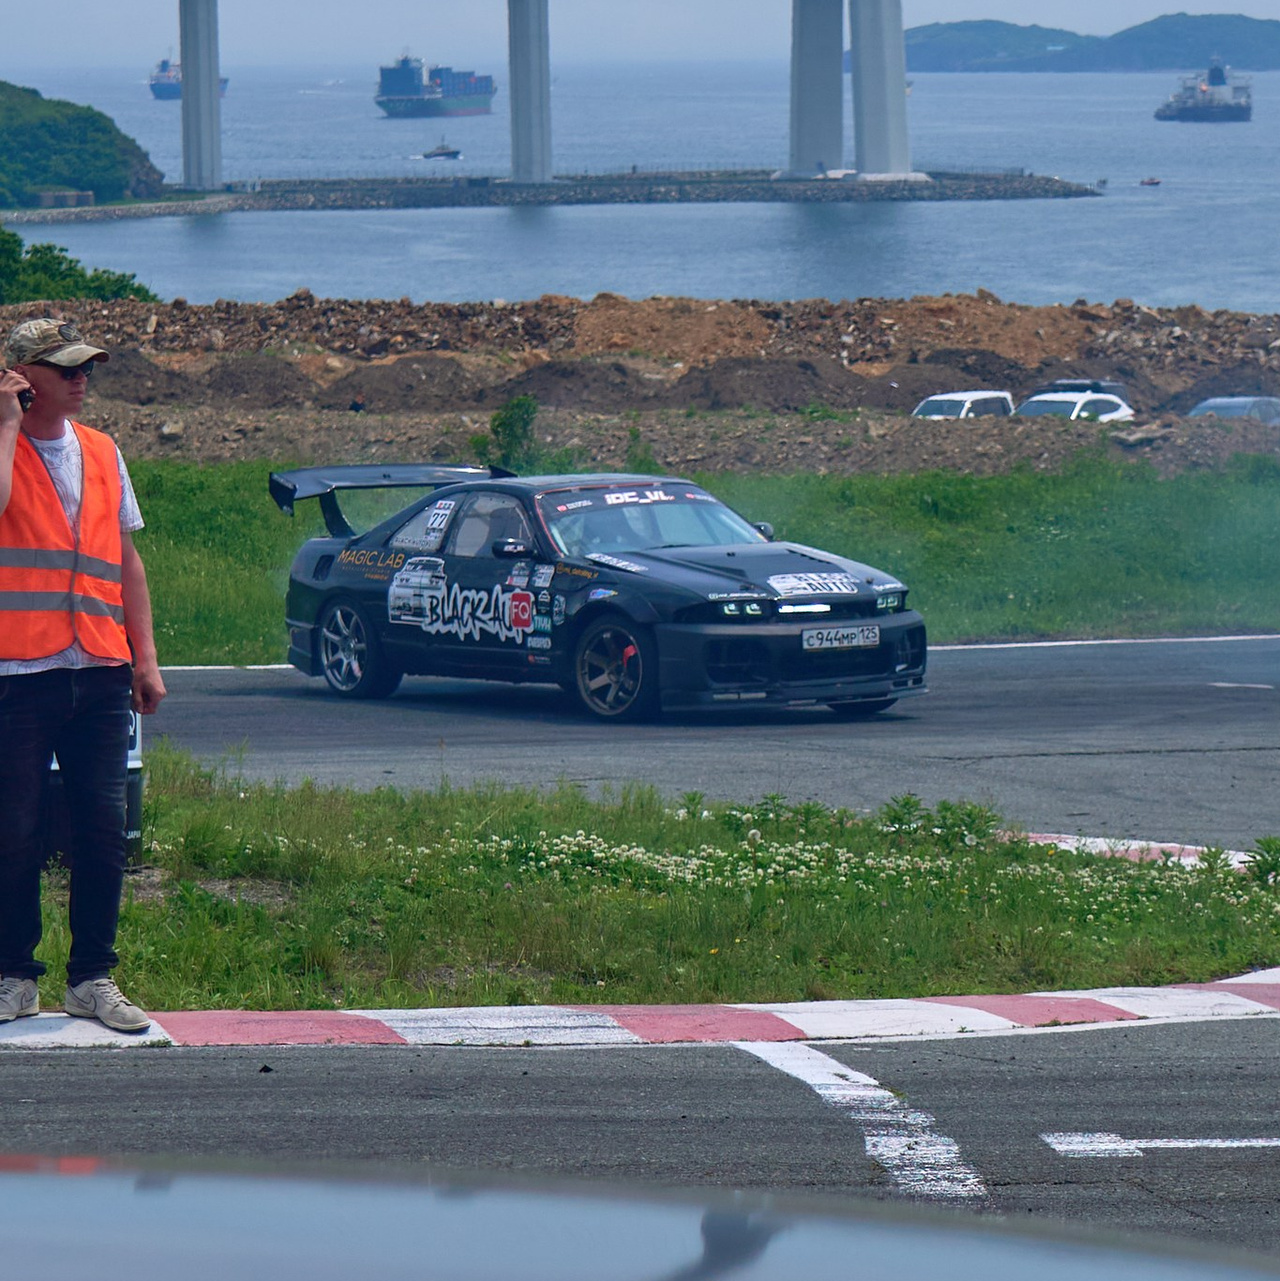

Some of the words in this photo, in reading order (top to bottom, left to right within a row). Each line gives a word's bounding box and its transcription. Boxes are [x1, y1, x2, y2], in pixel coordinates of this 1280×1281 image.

[430, 512, 448, 528] 77
[337, 549, 378, 566] MAGIC
[377, 552, 405, 569] LAB
[511, 601, 530, 620] FQ
[859, 627, 878, 640] 125
